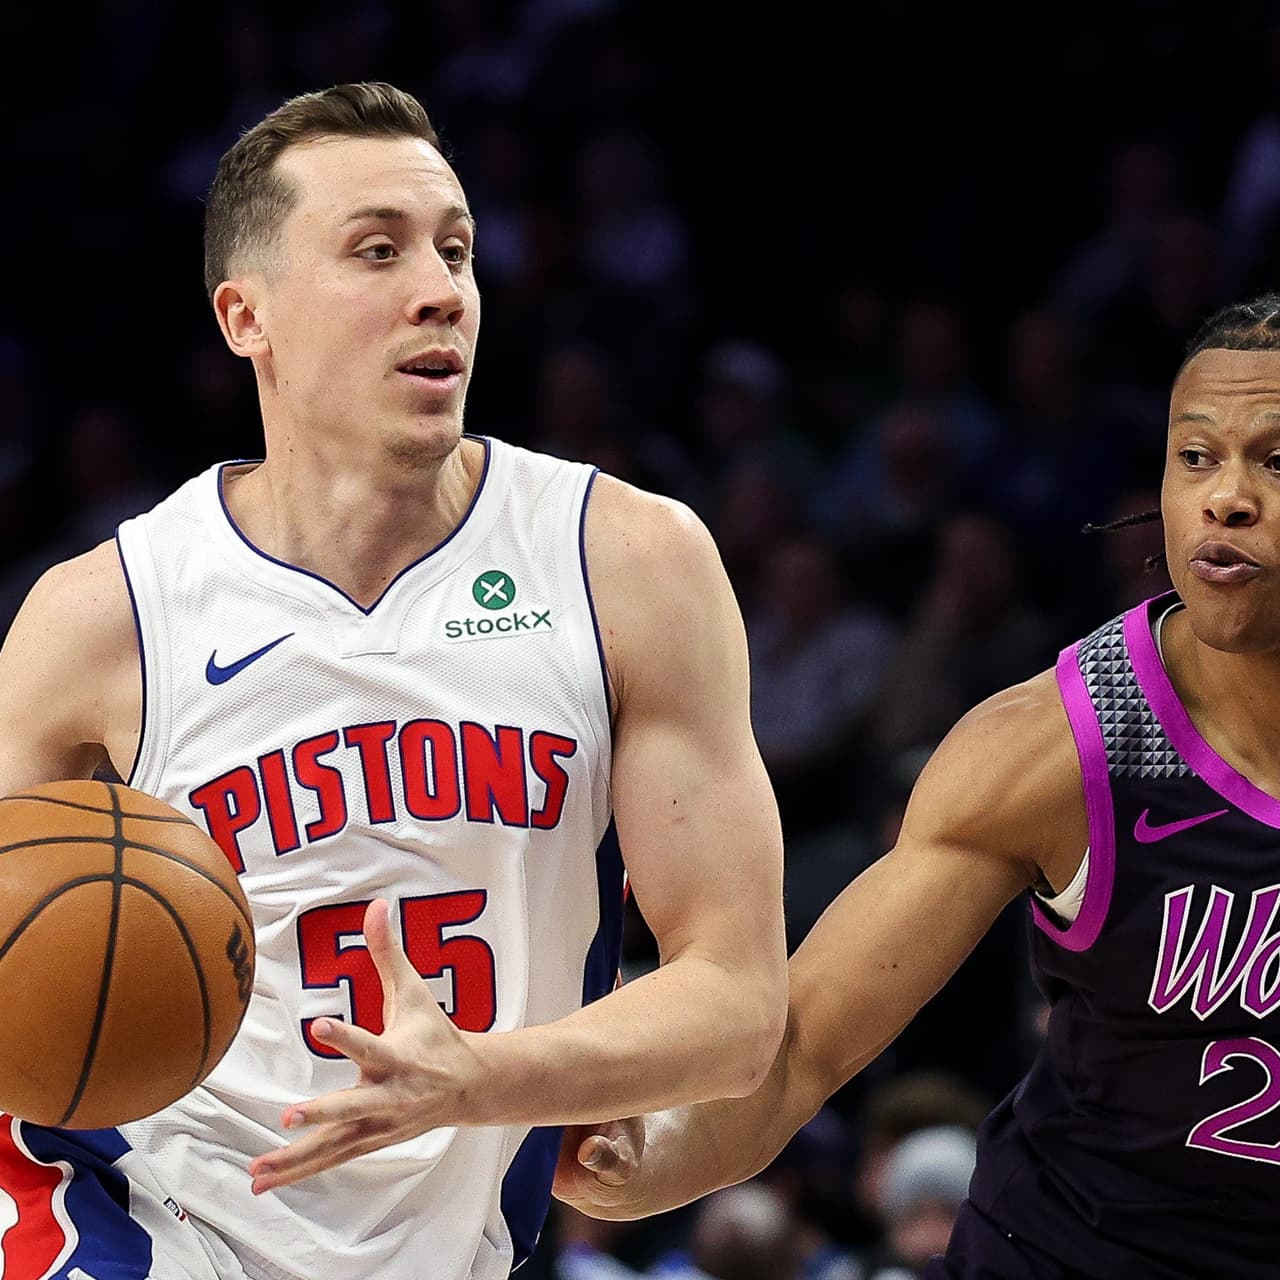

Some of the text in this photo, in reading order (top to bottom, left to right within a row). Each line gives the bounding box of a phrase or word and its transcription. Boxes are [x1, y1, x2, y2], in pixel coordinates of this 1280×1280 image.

[444, 609, 553, 638] StockX
[189, 718, 577, 875] PISTONS
[296, 888, 498, 1060] 55
